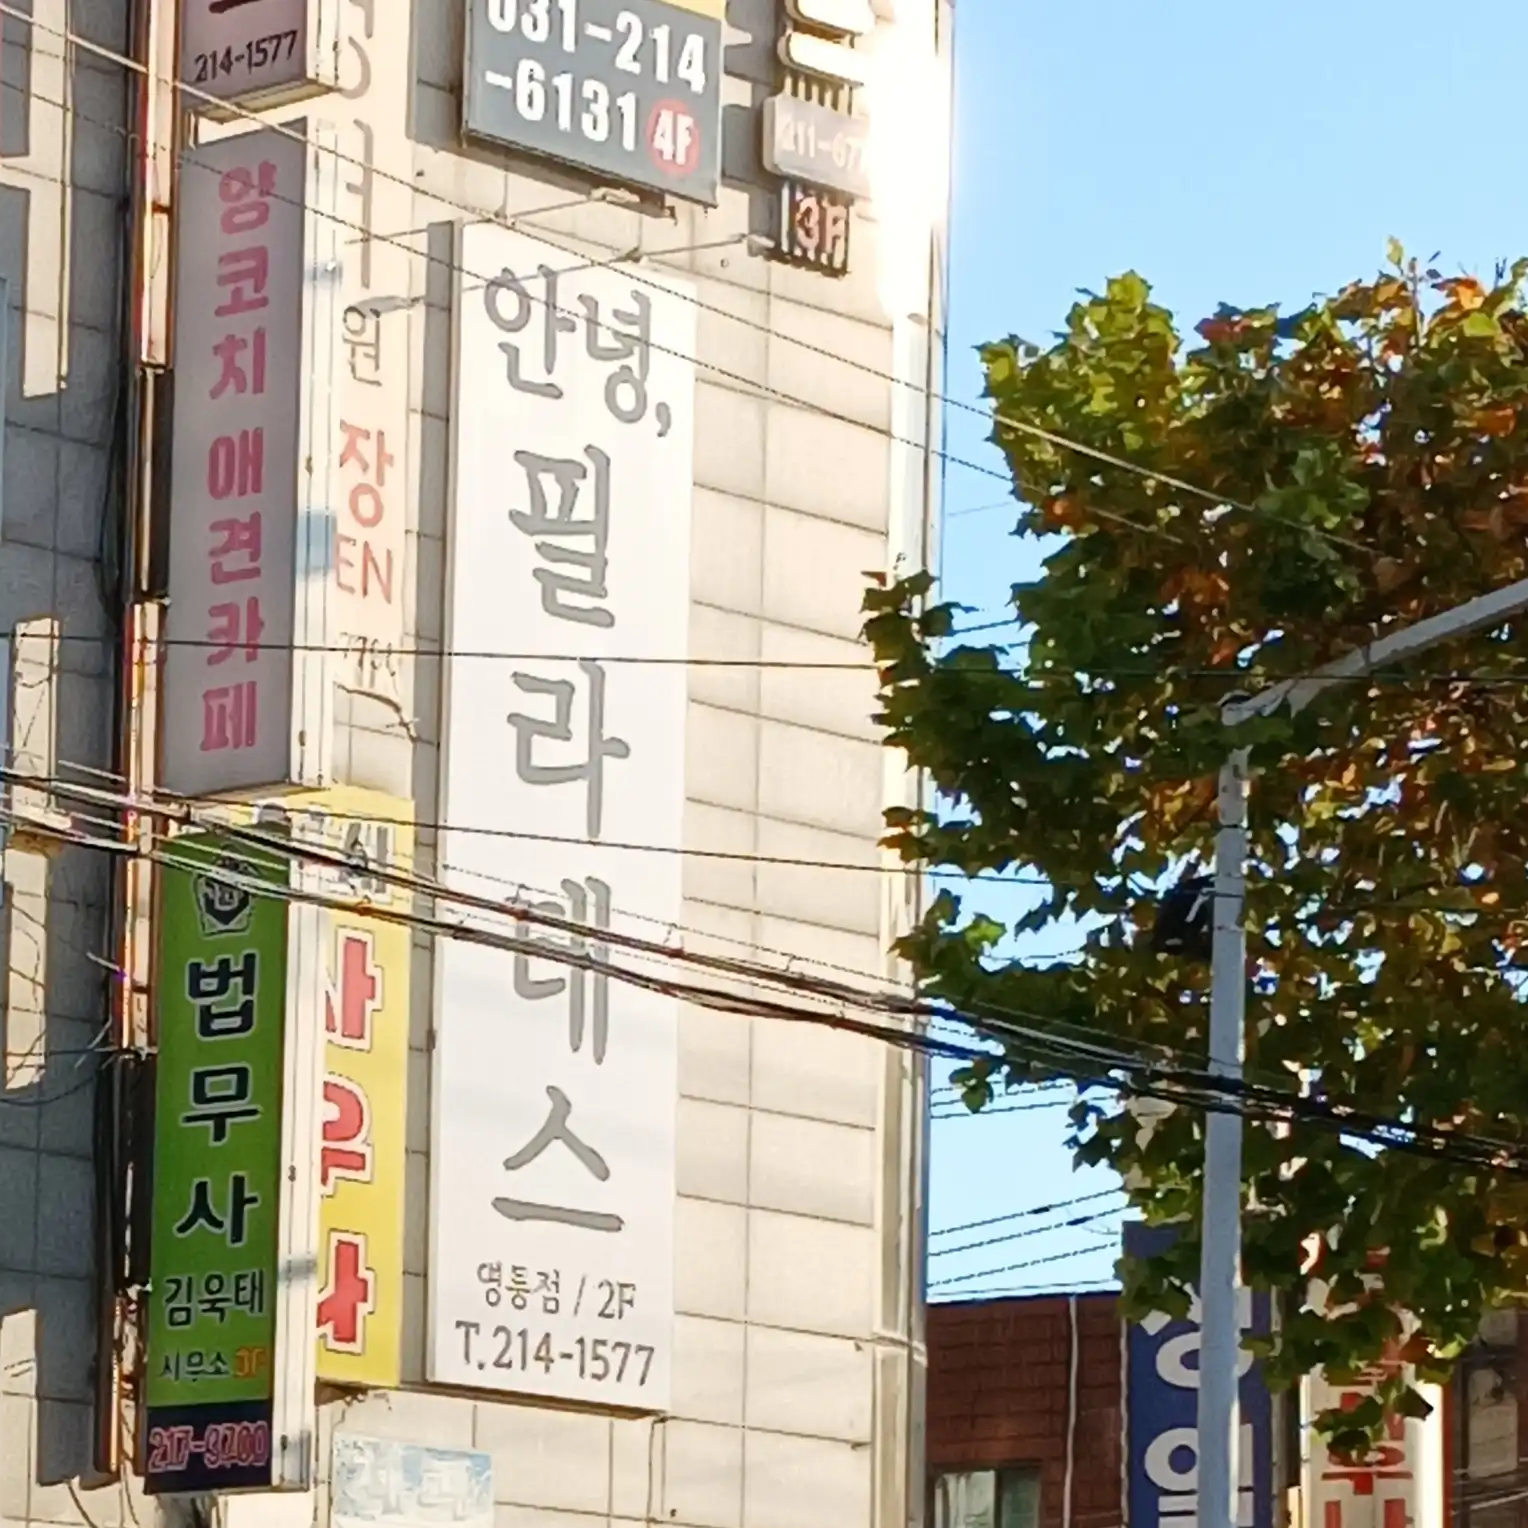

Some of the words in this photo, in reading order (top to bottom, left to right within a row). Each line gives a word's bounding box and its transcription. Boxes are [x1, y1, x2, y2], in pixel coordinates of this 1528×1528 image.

[194, 29, 299, 83] 214-1577
[653, 108, 695, 166] 4F
[483, 263, 673, 441] 안녕,
[199, 427, 267, 753] 애견카페
[491, 443, 632, 1235] 필라테스
[173, 950, 262, 1248] 법무사
[163, 1267, 267, 1328] 김욱태
[597, 1279, 637, 1321] 2F
[455, 1320, 656, 1387] T.214-1577
